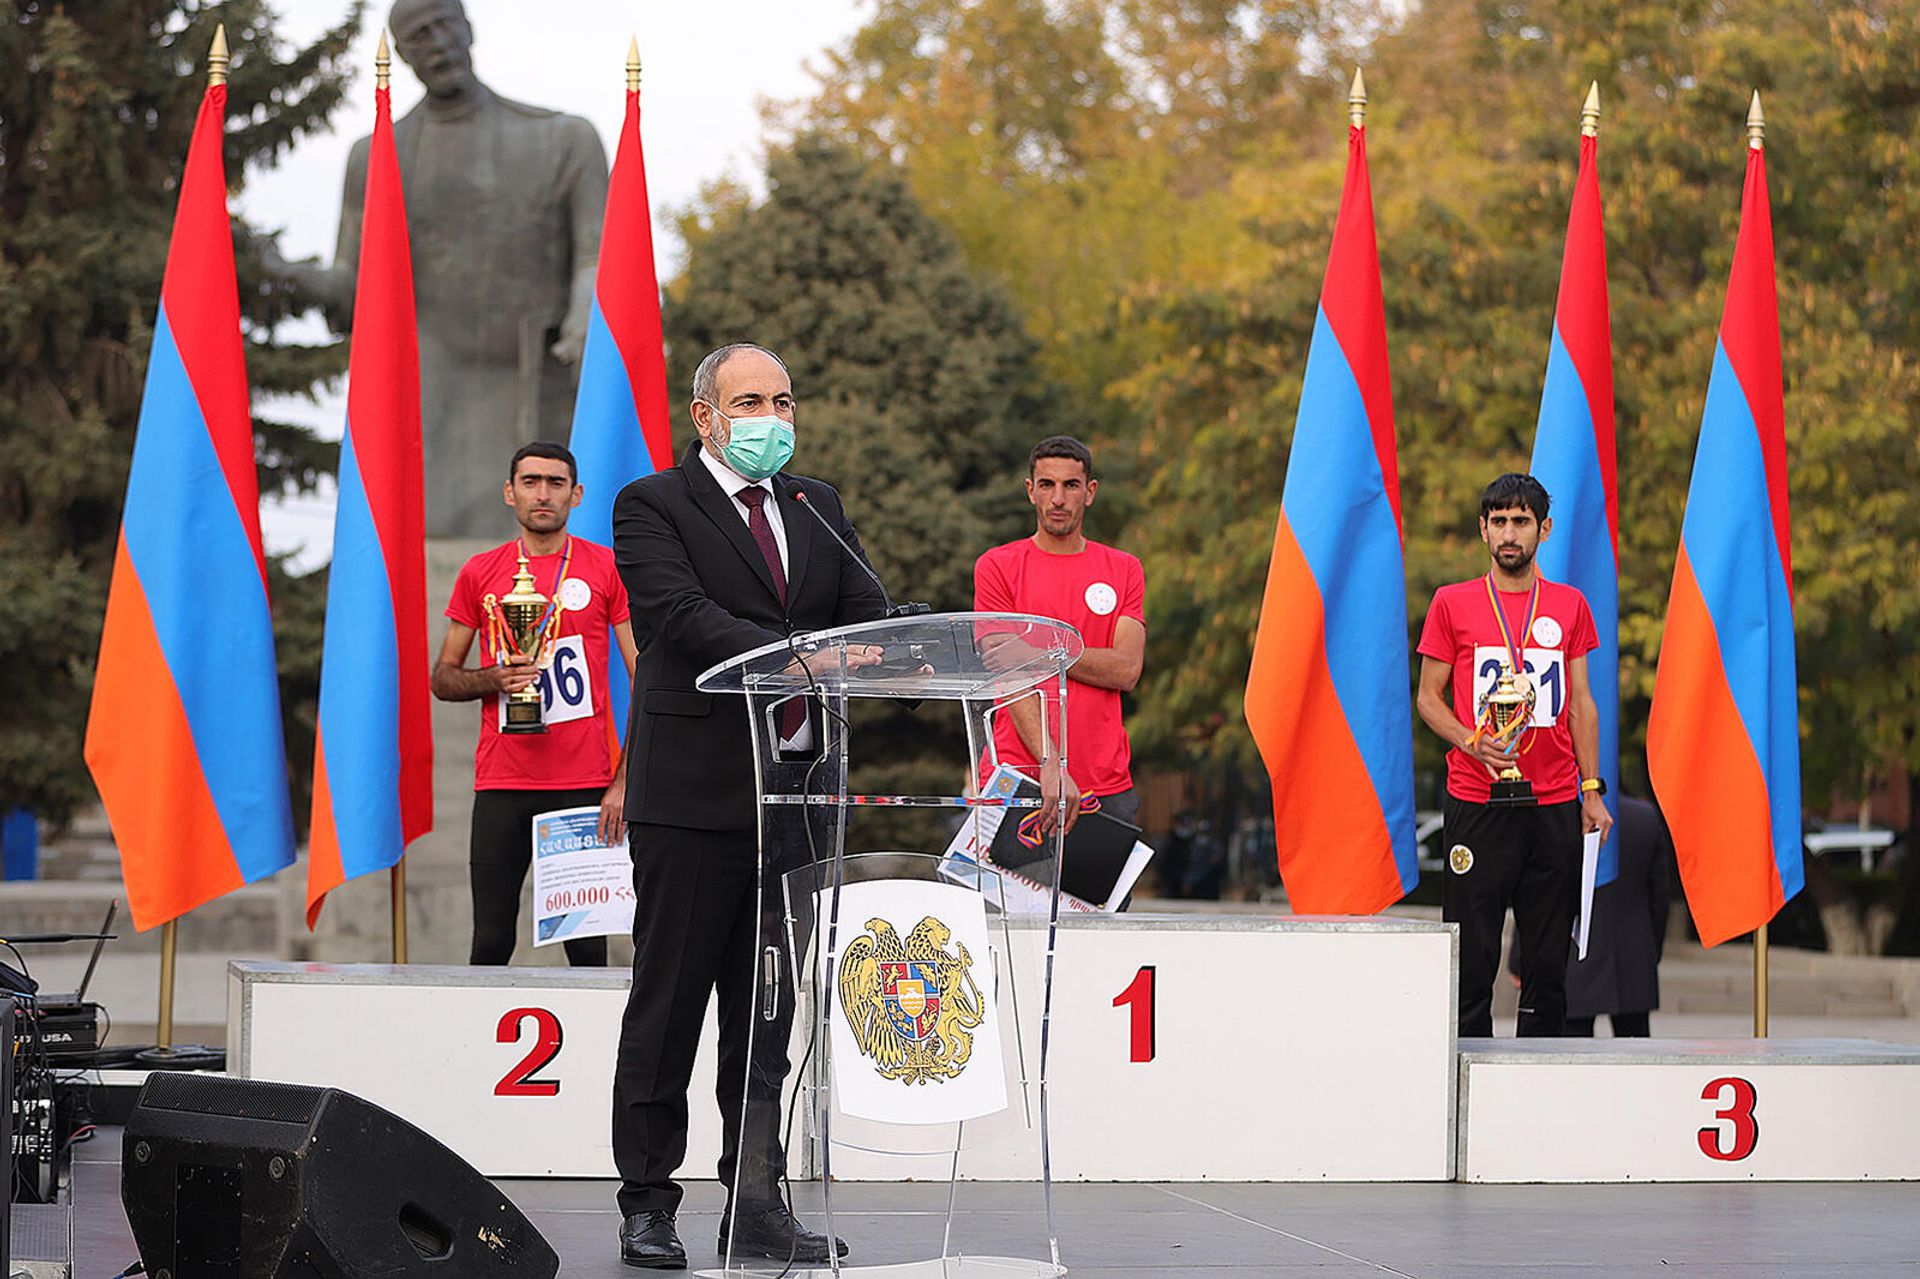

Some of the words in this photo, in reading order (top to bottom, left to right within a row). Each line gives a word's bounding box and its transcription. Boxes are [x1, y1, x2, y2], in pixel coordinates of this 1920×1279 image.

[546, 886, 609, 911] 600.000
[41, 1033, 72, 1043] USA
[494, 1007, 563, 1096] 2
[1112, 965, 1156, 1063] 1
[1697, 1077, 1759, 1161] 3
